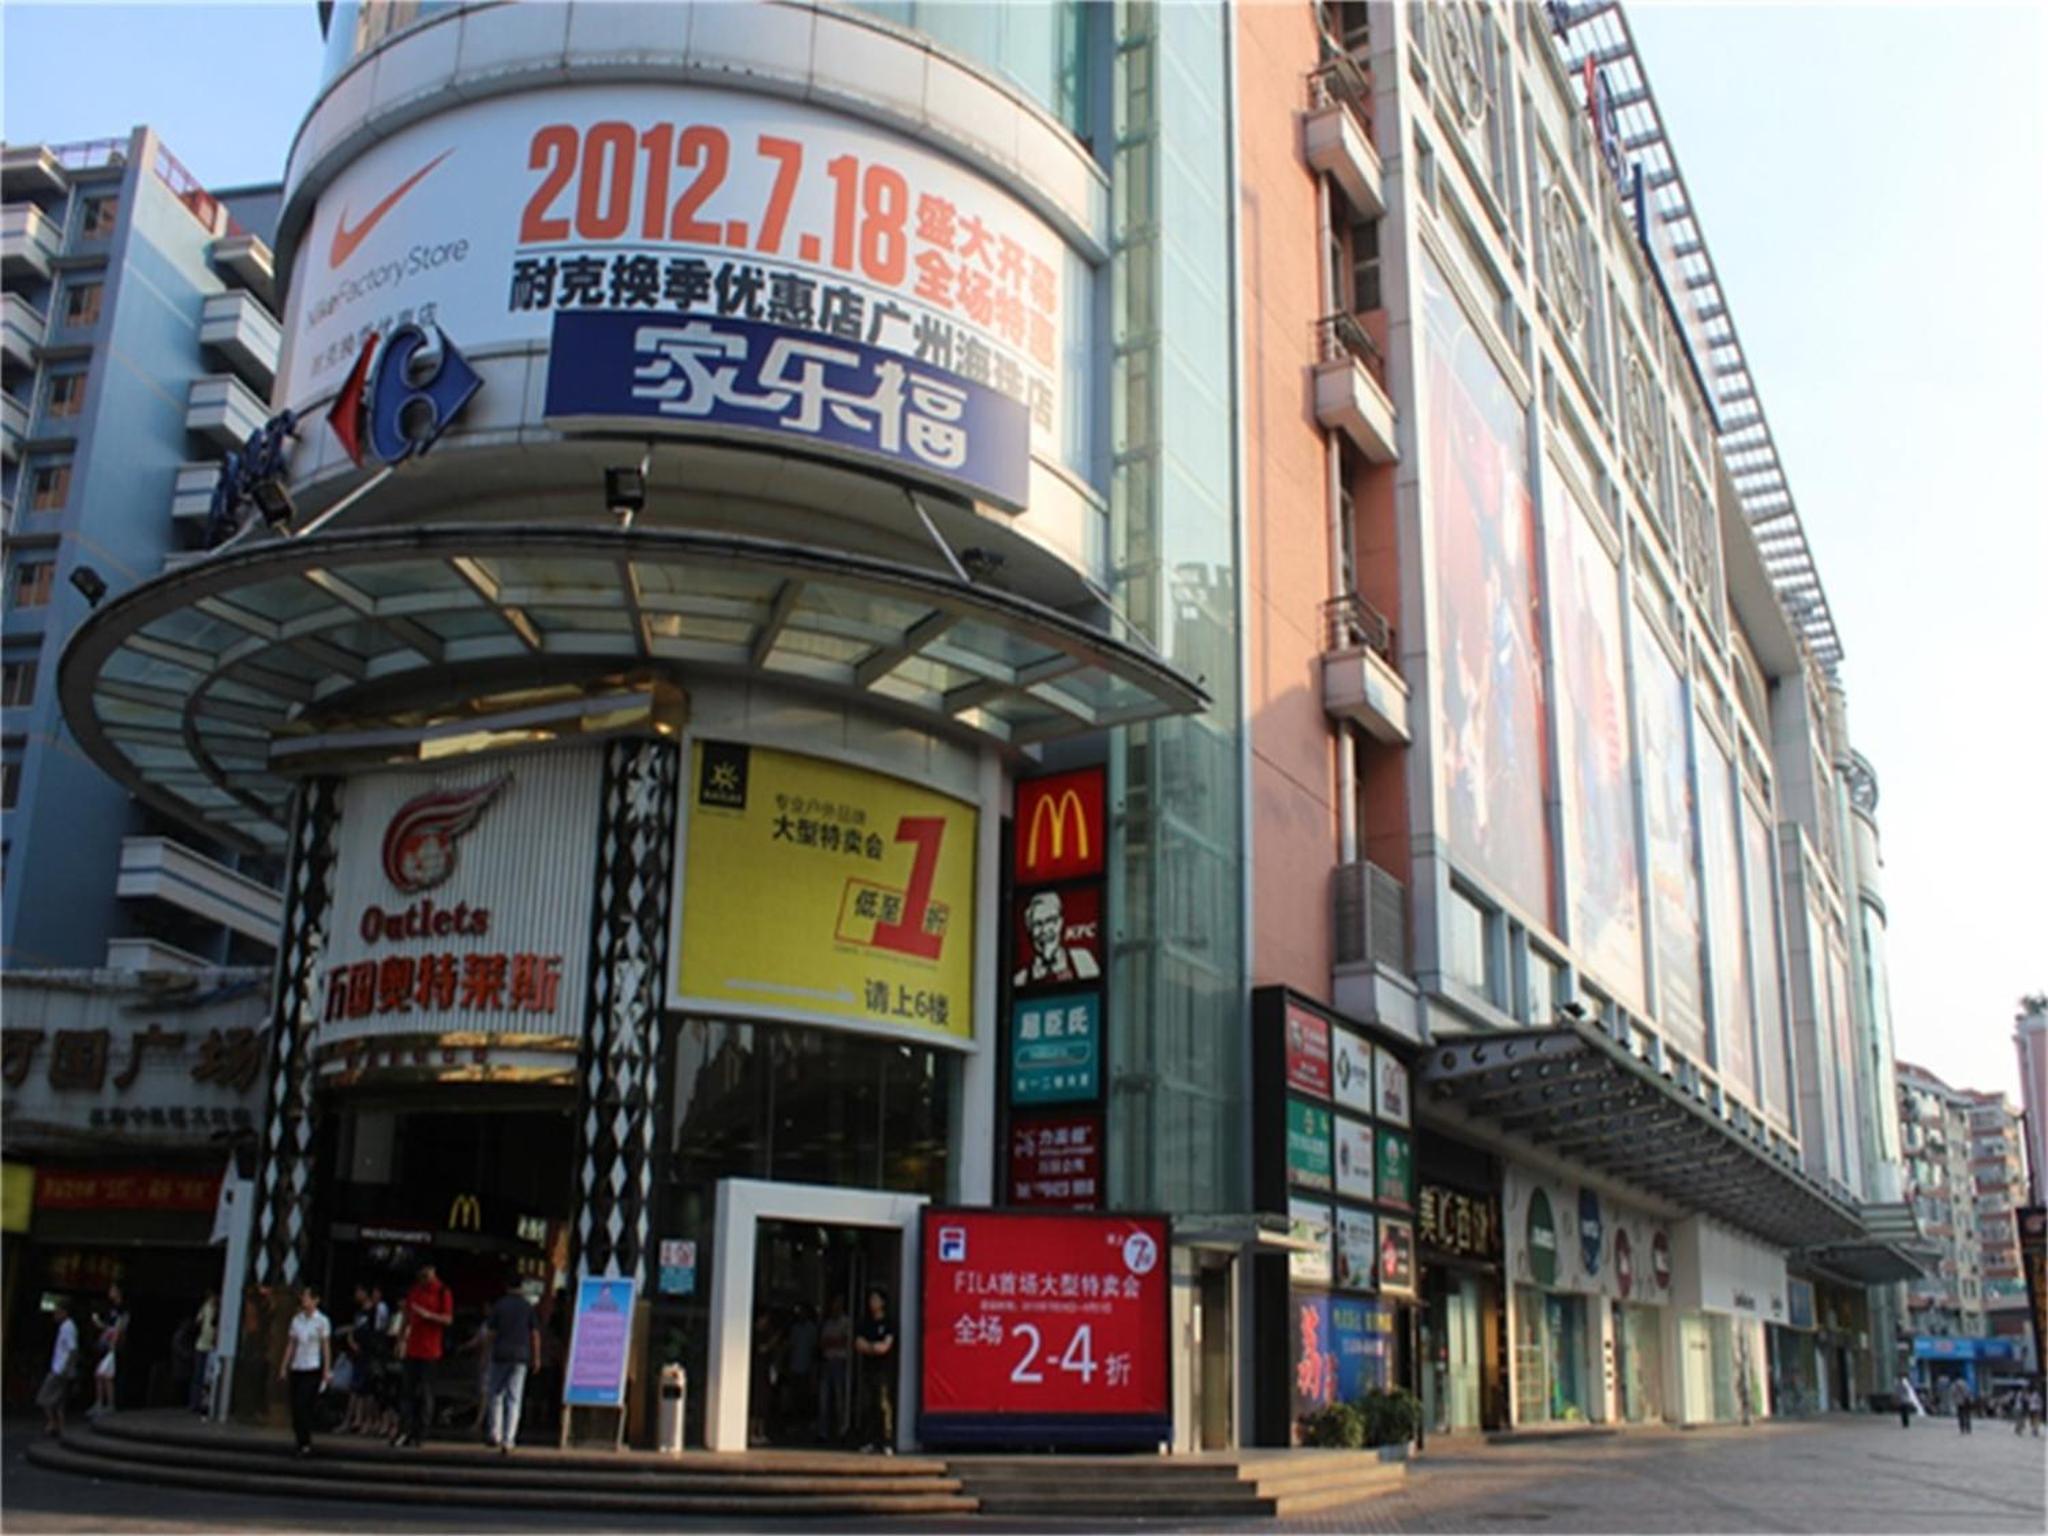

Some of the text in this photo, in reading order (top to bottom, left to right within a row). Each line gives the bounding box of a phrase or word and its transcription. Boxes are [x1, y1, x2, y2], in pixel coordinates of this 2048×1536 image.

[519, 121, 909, 286] 2012.7.18
[632, 322, 968, 470] 家乐福
[772, 815, 884, 860] 大型特卖会
[360, 899, 491, 944] Outlets
[853, 888, 903, 923] 低至
[864, 977, 950, 1026] 请上6楼
[954, 1270, 1142, 1299] FILA首场大型特卖会
